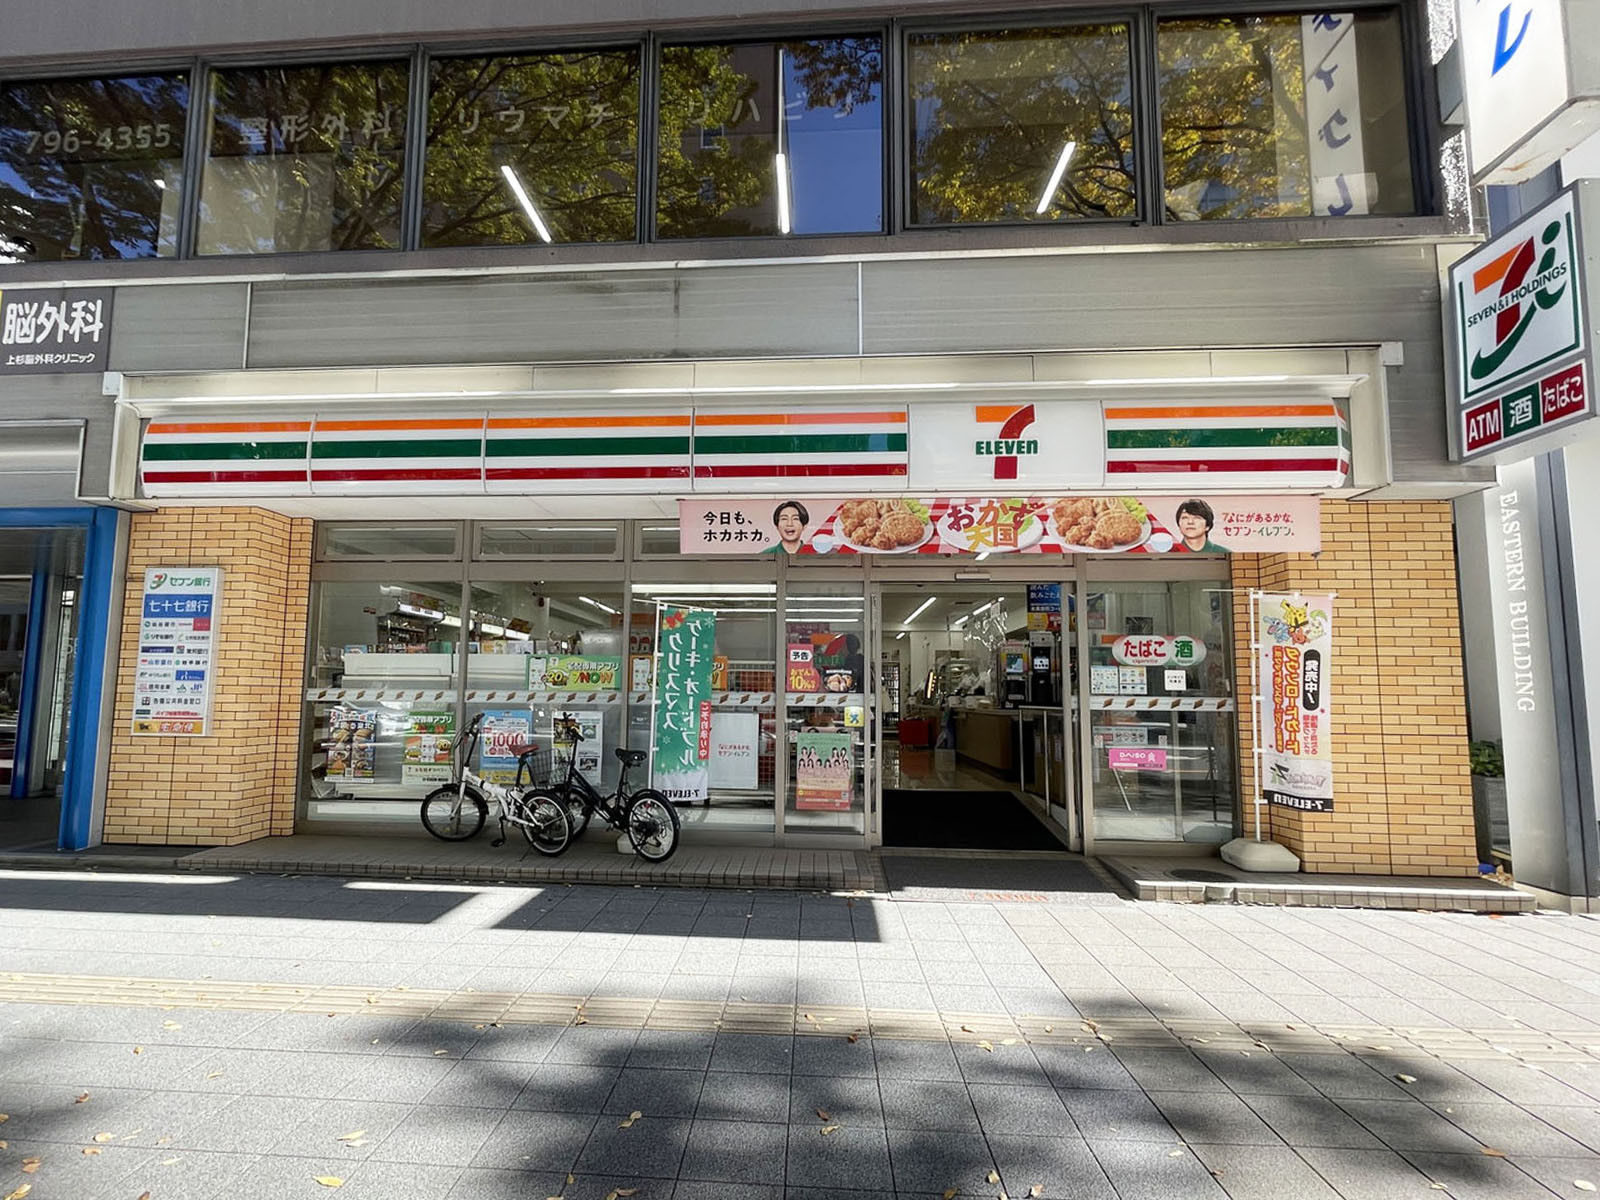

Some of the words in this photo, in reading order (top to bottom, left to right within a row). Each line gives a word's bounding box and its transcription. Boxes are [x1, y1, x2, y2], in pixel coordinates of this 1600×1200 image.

[26, 123, 171, 154] 796-4355
[1510, 262, 1568, 302] HOLDINGS
[2, 299, 104, 344] 脳外科
[5, 352, 96, 366] 上杉脳外科クリニック
[1542, 375, 1584, 413] たばこ
[1509, 394, 1533, 428] 酒
[1468, 406, 1500, 444] ATM
[702, 510, 754, 526] 今日も、
[702, 528, 771, 543] ホカホカ。
[1500, 490, 1526, 592] EASTERN
[169, 576, 211, 588] セブン銀行
[148, 599, 209, 614] 七十七銀行
[792, 650, 809, 661] 予告
[1123, 639, 1167, 658] たばこ
[1174, 640, 1194, 658] 酒
[1509, 599, 1535, 713] BUILDING
